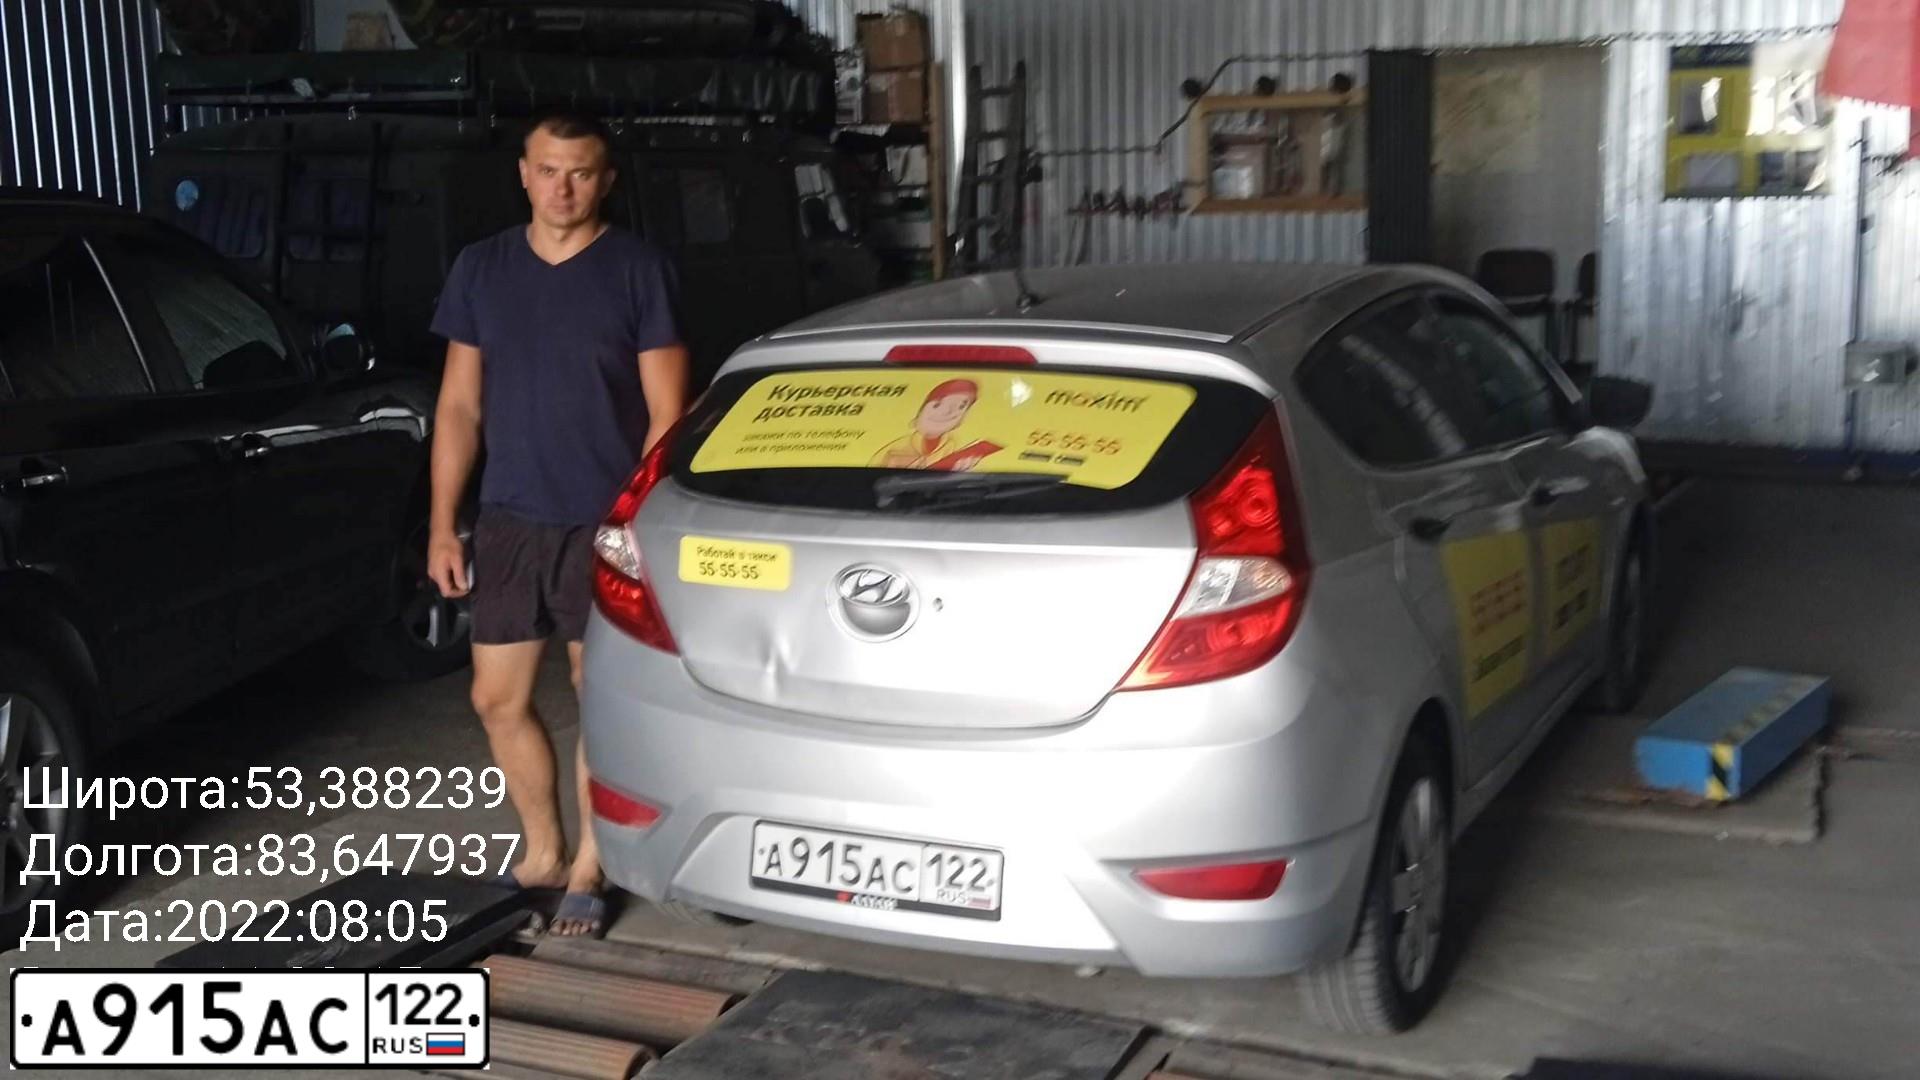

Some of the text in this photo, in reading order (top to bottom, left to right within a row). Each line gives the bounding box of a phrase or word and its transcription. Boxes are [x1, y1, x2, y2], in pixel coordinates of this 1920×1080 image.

[767, 384, 908, 402] Курьерская
[1044, 389, 1143, 413] maxim
[752, 402, 865, 423] доставка
[697, 545, 735, 560] Работай
[927, 852, 988, 892] 122
[936, 888, 967, 905] RUS
